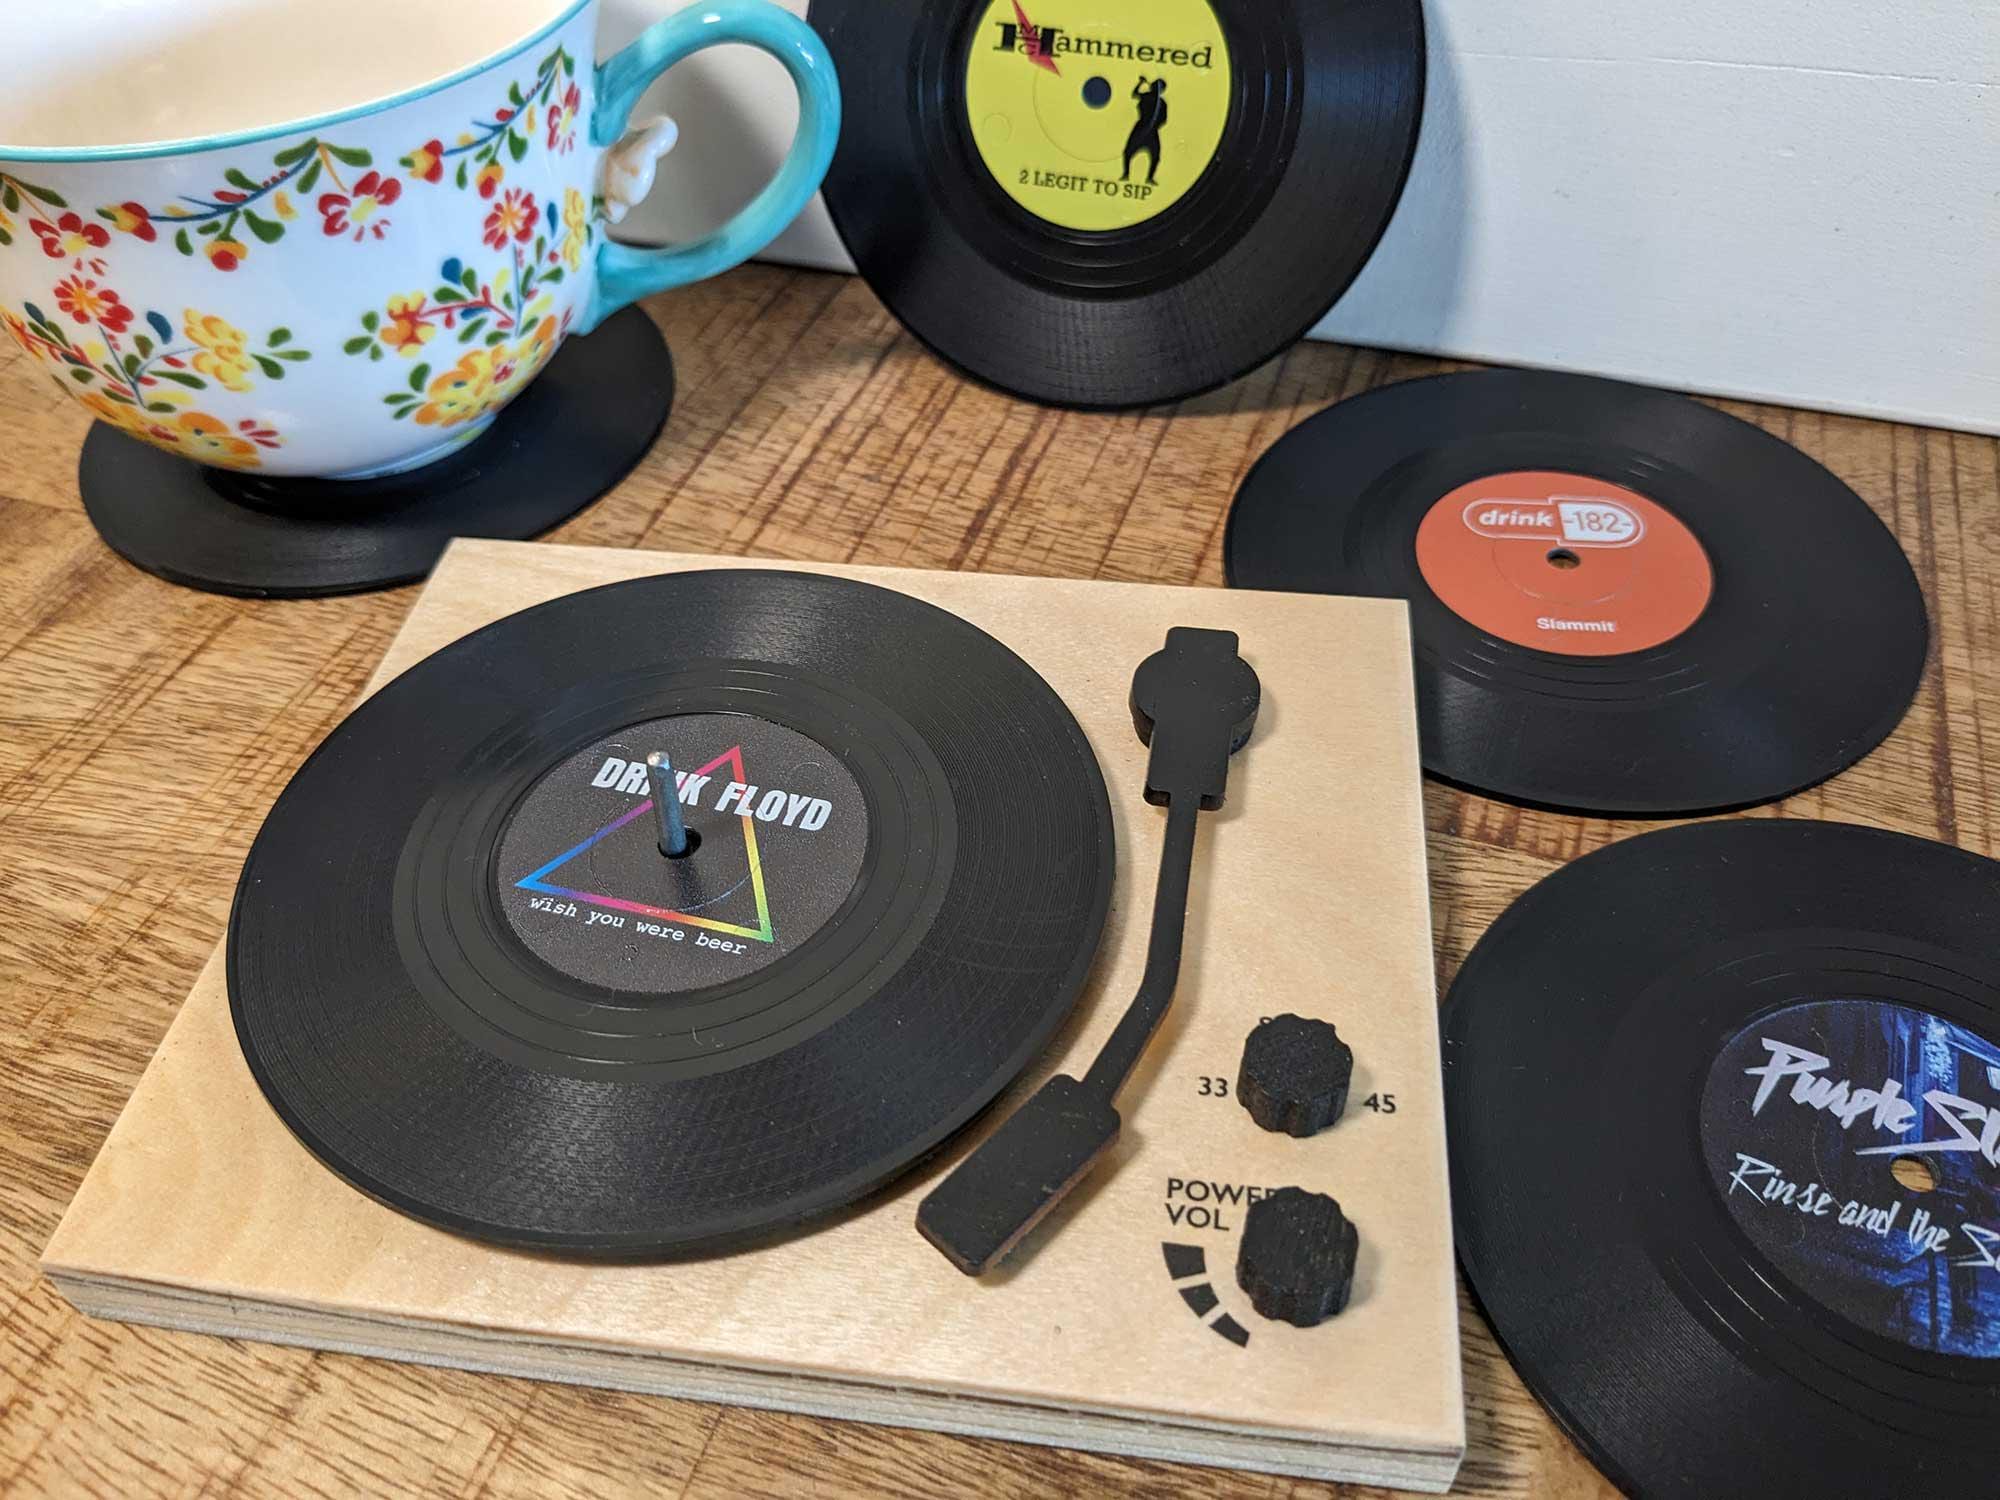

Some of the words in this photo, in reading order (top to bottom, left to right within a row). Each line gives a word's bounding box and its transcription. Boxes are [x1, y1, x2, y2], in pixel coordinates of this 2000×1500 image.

[1018, 169, 1029, 185] 2
[1034, 171, 1088, 193] LEGIT
[1092, 179, 1119, 197] TO
[1123, 184, 1153, 201] SIP
[1478, 509, 1554, 528] drink
[1536, 617, 1617, 633] Slammit
[714, 781, 834, 832] FLOYD
[529, 896, 577, 918] wish
[585, 911, 625, 929] you
[636, 920, 686, 942] were
[695, 932, 748, 955] beer
[1197, 1076, 1229, 1097] 33
[1363, 1092, 1397, 1114] 45
[1744, 1036, 1918, 1135] Purple
[1164, 1202, 1231, 1232] VOL
[1728, 1152, 1833, 1217] Rinse
[1838, 1200, 1902, 1239] and
[1908, 1207, 1951, 1252] the
